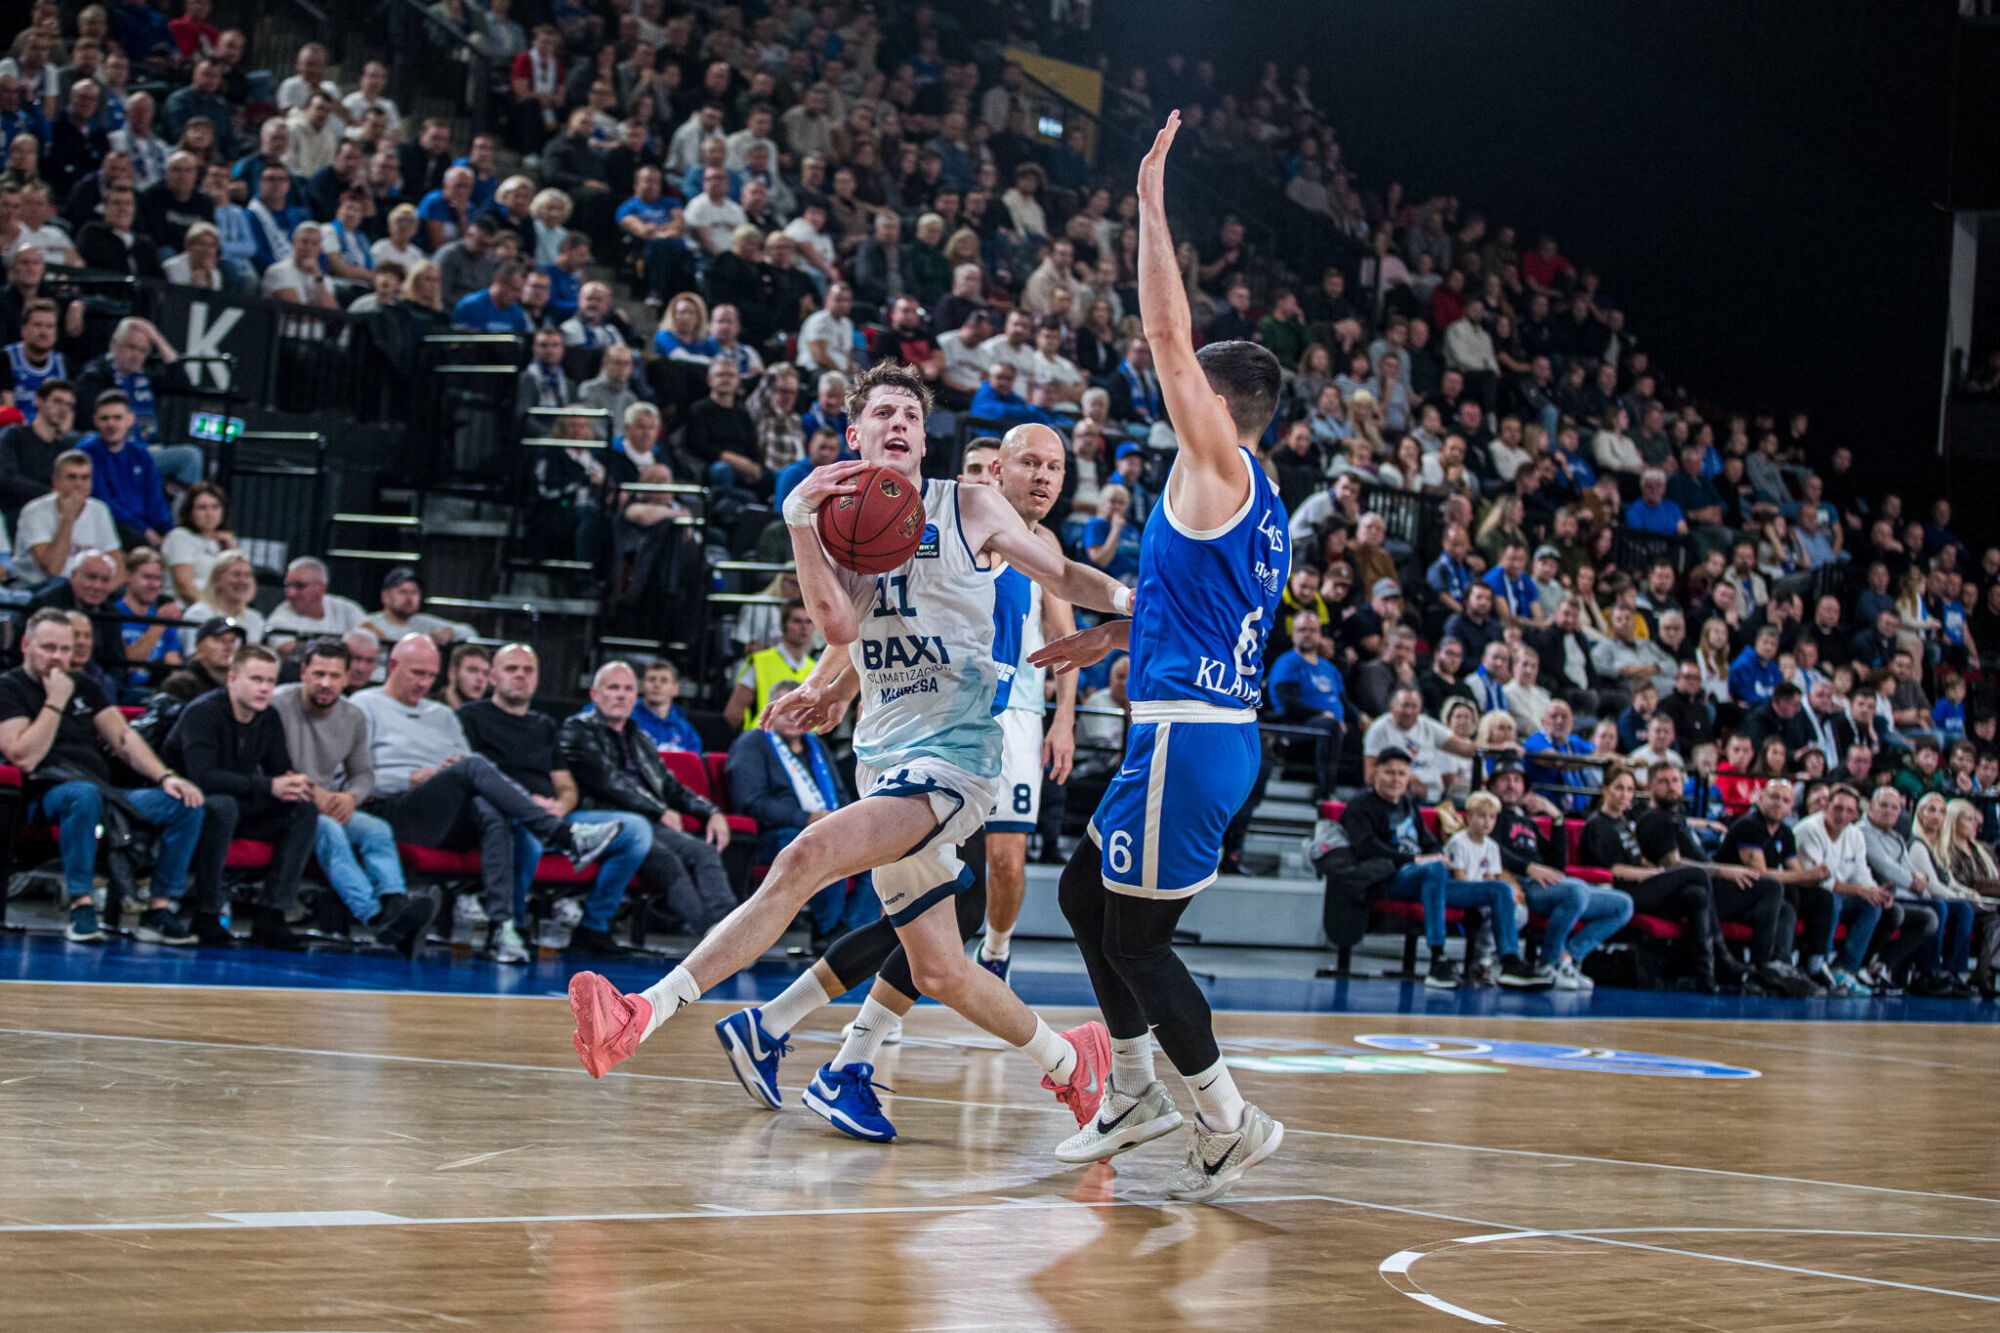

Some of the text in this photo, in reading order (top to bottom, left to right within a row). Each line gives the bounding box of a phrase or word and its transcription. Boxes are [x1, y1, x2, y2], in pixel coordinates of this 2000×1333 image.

[184, 302, 245, 391] K
[873, 575, 917, 617] 11
[862, 635, 950, 670] BAXI
[1013, 783, 1031, 814] 8
[1109, 830, 1133, 874] 6
